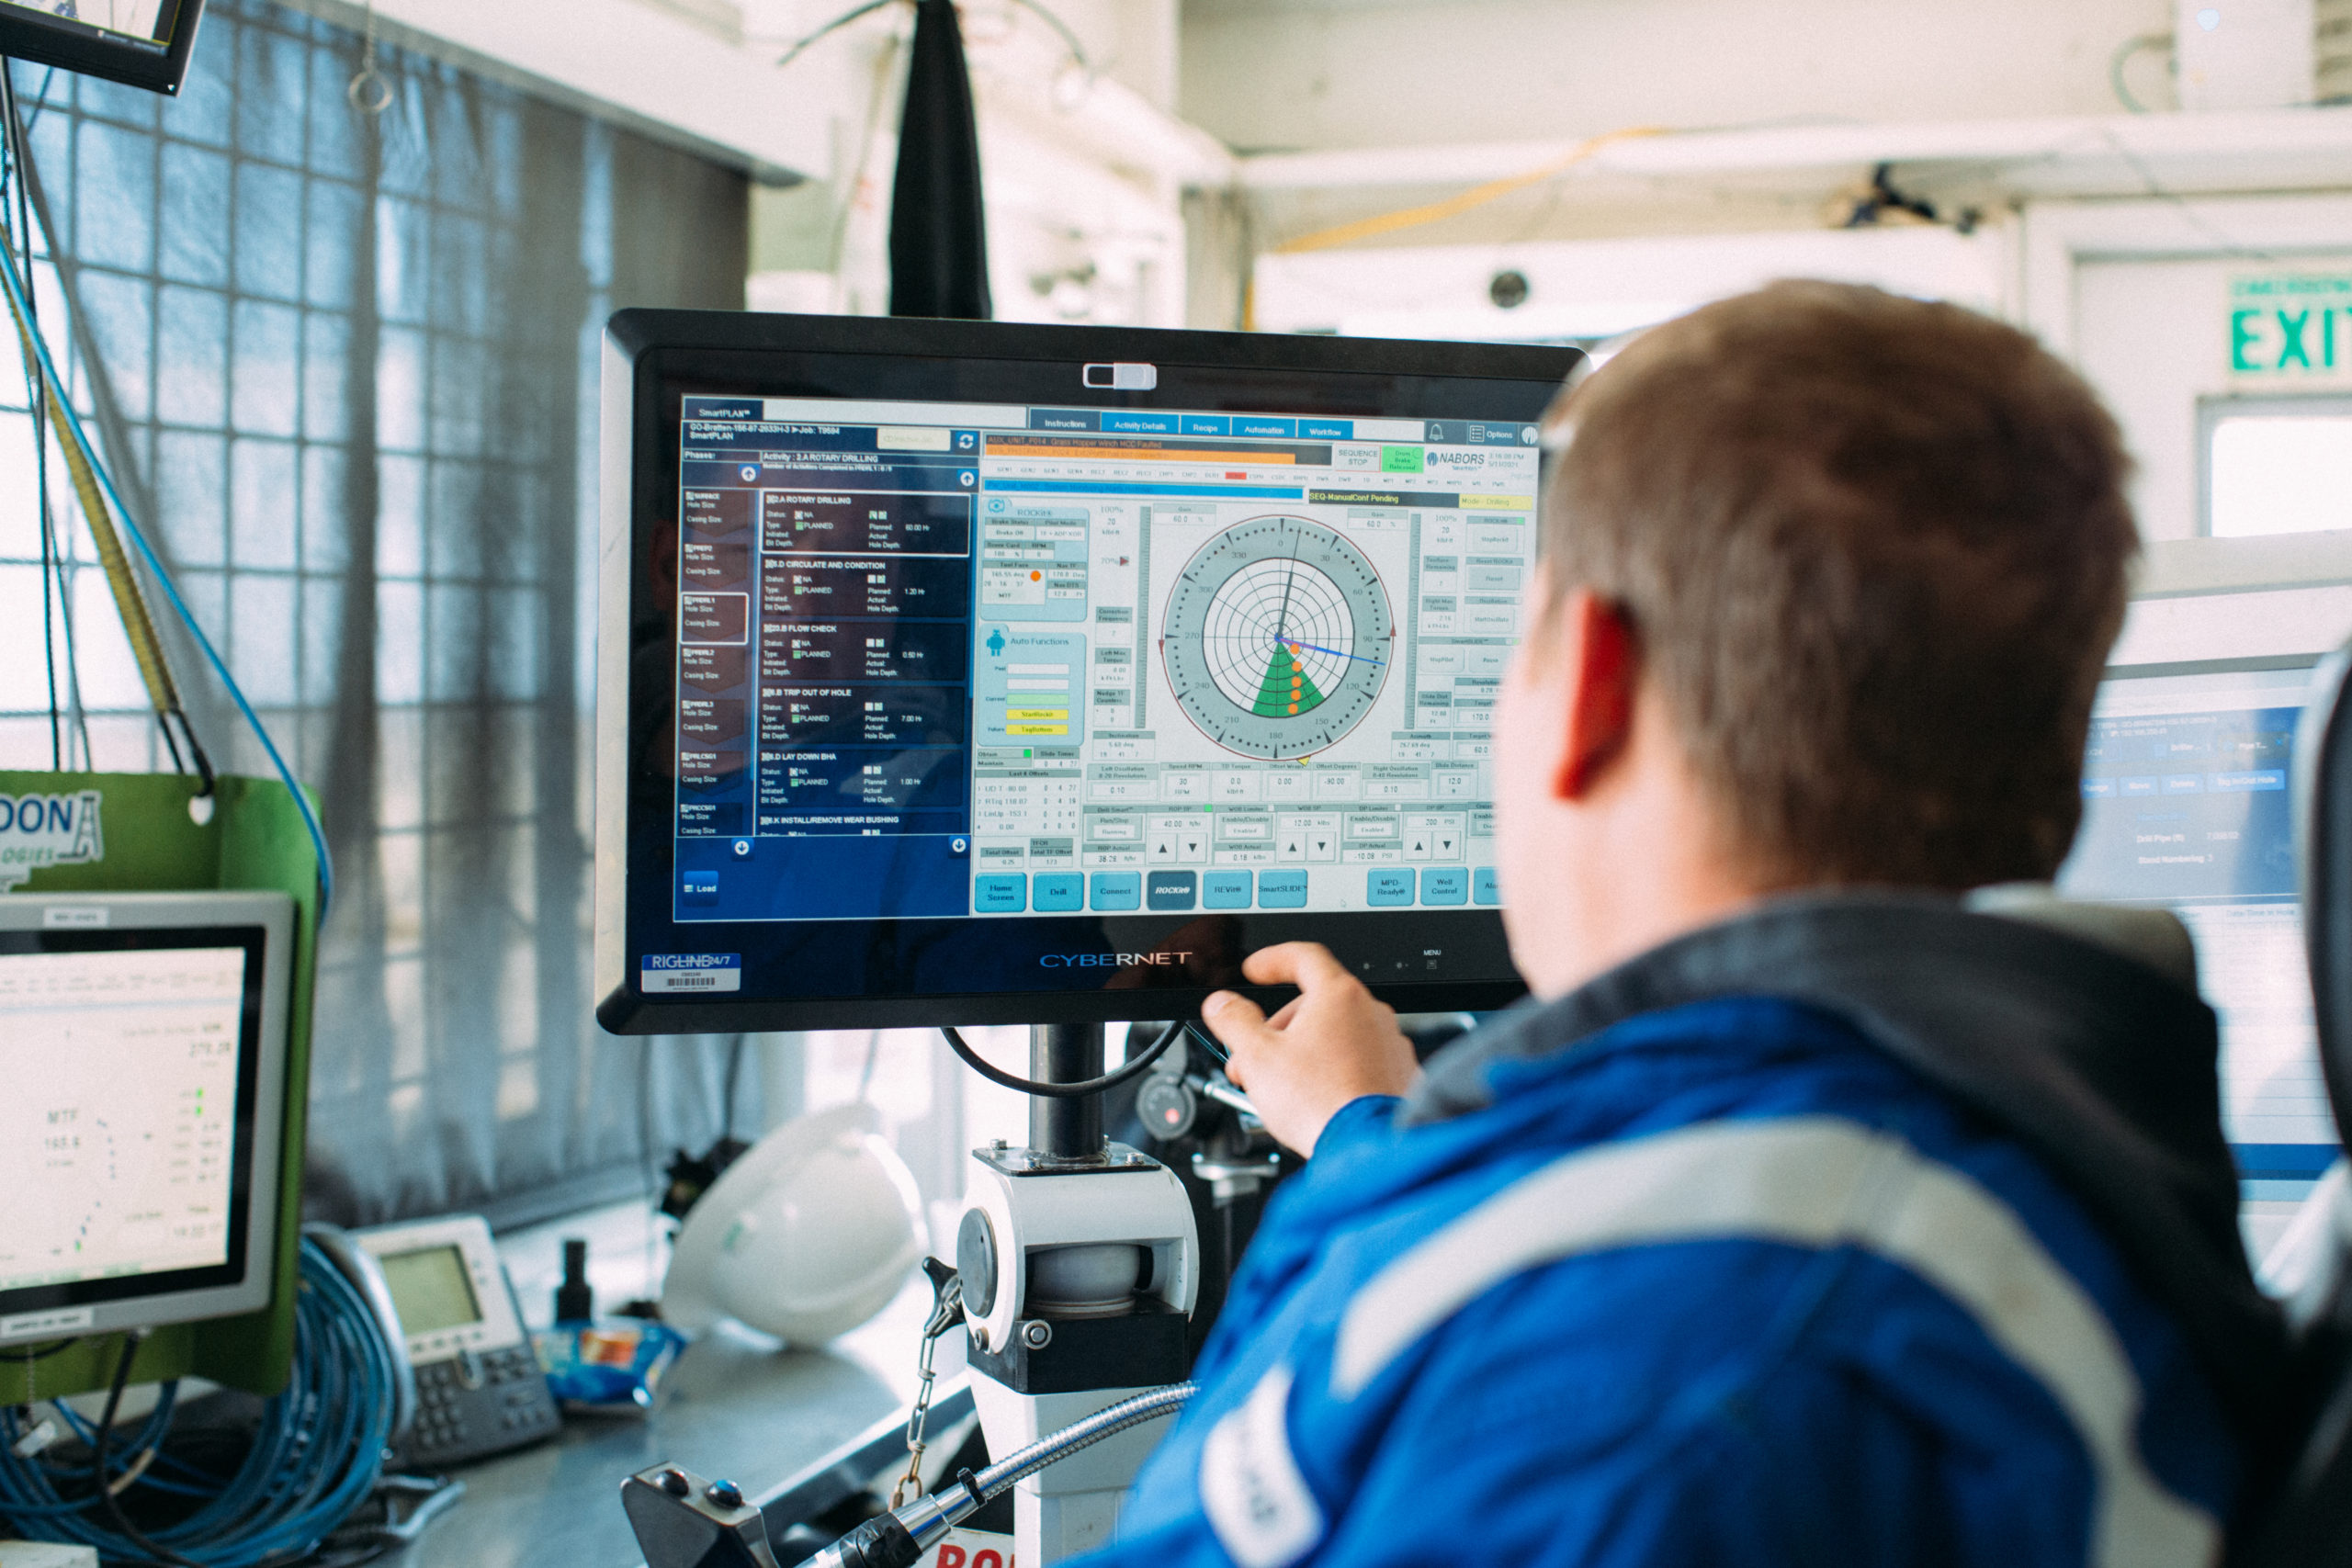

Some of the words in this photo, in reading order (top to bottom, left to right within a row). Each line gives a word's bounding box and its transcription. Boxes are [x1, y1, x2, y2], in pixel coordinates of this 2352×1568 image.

[2232, 307, 2352, 370] EXI
[1045, 420, 1087, 428] Instructions
[1114, 422, 1141, 430] Activity
[1193, 424, 1218, 433] Recipe
[1245, 426, 1284, 434] Automation
[1309, 428, 1341, 436] Workflow
[690, 431, 734, 440] SmartPLAN
[1487, 430, 1513, 439] Options
[1338, 449, 1378, 457] SEQUENCE
[842, 455, 878, 463] DRILLING
[1440, 452, 1485, 465] NABORS
[786, 496, 816, 504] ROTARY
[1371, 494, 1399, 504] Pending
[1277, 539, 1283, 547] 0
[1231, 551, 1247, 559] 330
[1320, 554, 1330, 562] 30
[786, 560, 827, 569] CIRCULATE
[844, 561, 886, 570] CONDITION
[1352, 588, 1363, 596] 60
[788, 625, 810, 633] FLOW
[831, 689, 852, 697] HOLE
[1224, 716, 1239, 724] 210
[1315, 717, 1329, 726] 150
[696, 885, 717, 893] Load
[651, 955, 710, 968] RIGLINE
[1039, 952, 1193, 968] CYBERNET
